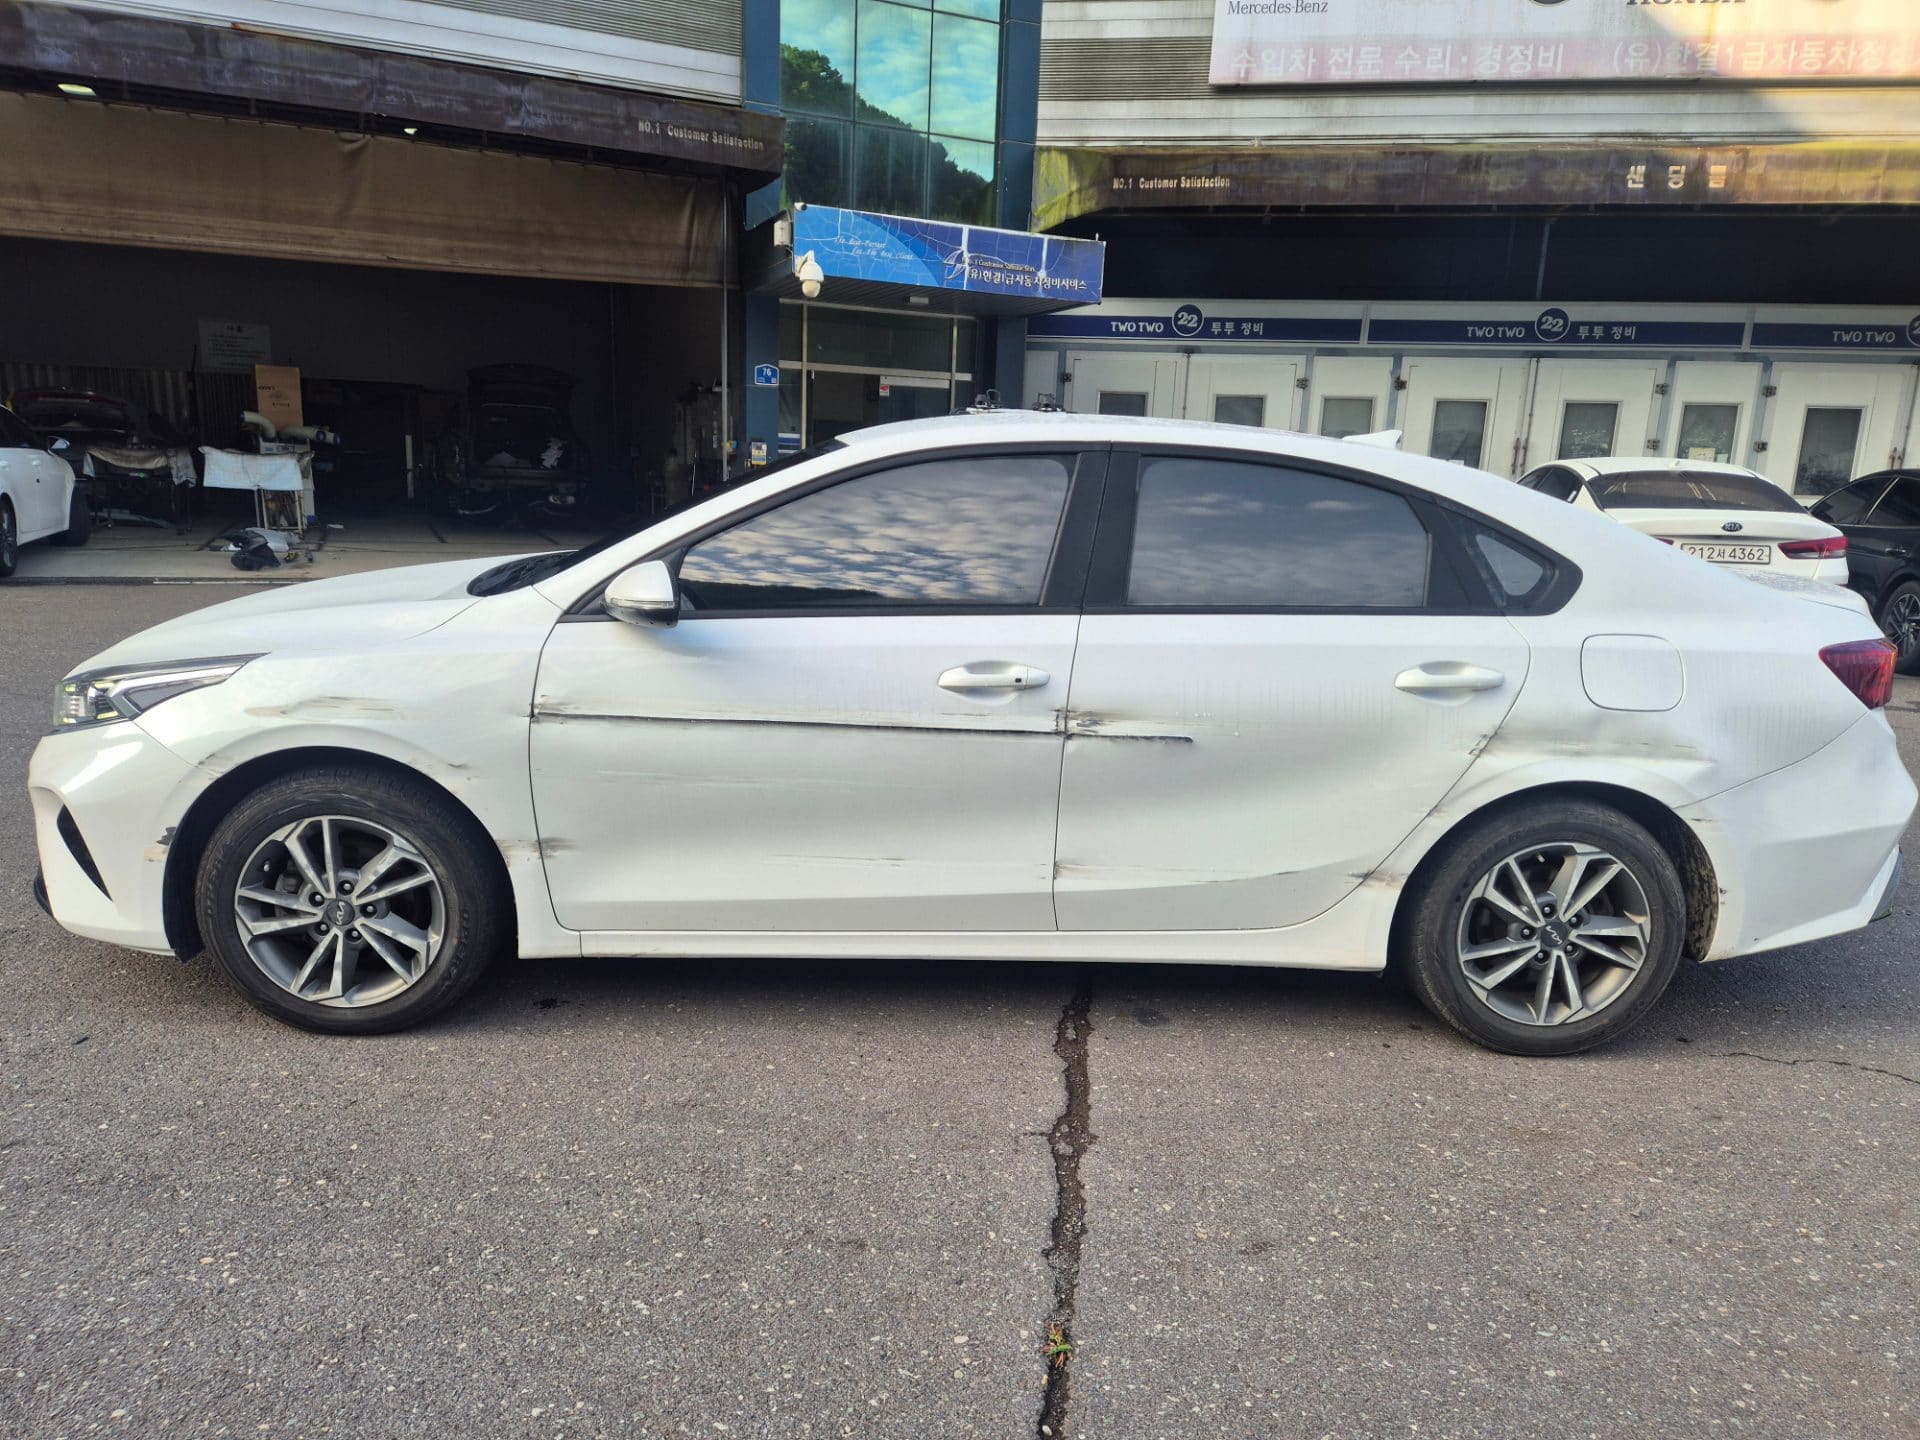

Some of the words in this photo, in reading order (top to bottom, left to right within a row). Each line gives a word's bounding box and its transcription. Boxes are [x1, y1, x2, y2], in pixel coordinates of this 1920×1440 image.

[1227, 0, 1328, 15] Mercedes-Benz
[1231, 48, 1316, 78] 수입차
[1328, 46, 1382, 76] 전문
[638, 120, 660, 135] NO.1
[667, 125, 709, 143] Customer
[712, 131, 764, 150] Satisfaction
[1112, 177, 1133, 190] NO.1
[1138, 177, 1178, 189] Customer
[1180, 175, 1230, 189] Satisfaction
[1111, 321, 1136, 333] TWO
[1138, 321, 1164, 333] TWO
[1177, 311, 1199, 328] 22
[1211, 321, 1235, 336] 투투
[1241, 322, 1264, 336] 정비
[1467, 326, 1494, 338] TWO
[1497, 326, 1526, 338] TWO
[1540, 315, 1564, 332] 22
[1577, 325, 1604, 340] 투투
[1611, 326, 1636, 340] 정비
[1832, 330, 1862, 342] TWO
[1865, 331, 1896, 343] TWO
[762, 367, 772, 376] 76
[1724, 523, 1740, 531] KIA
